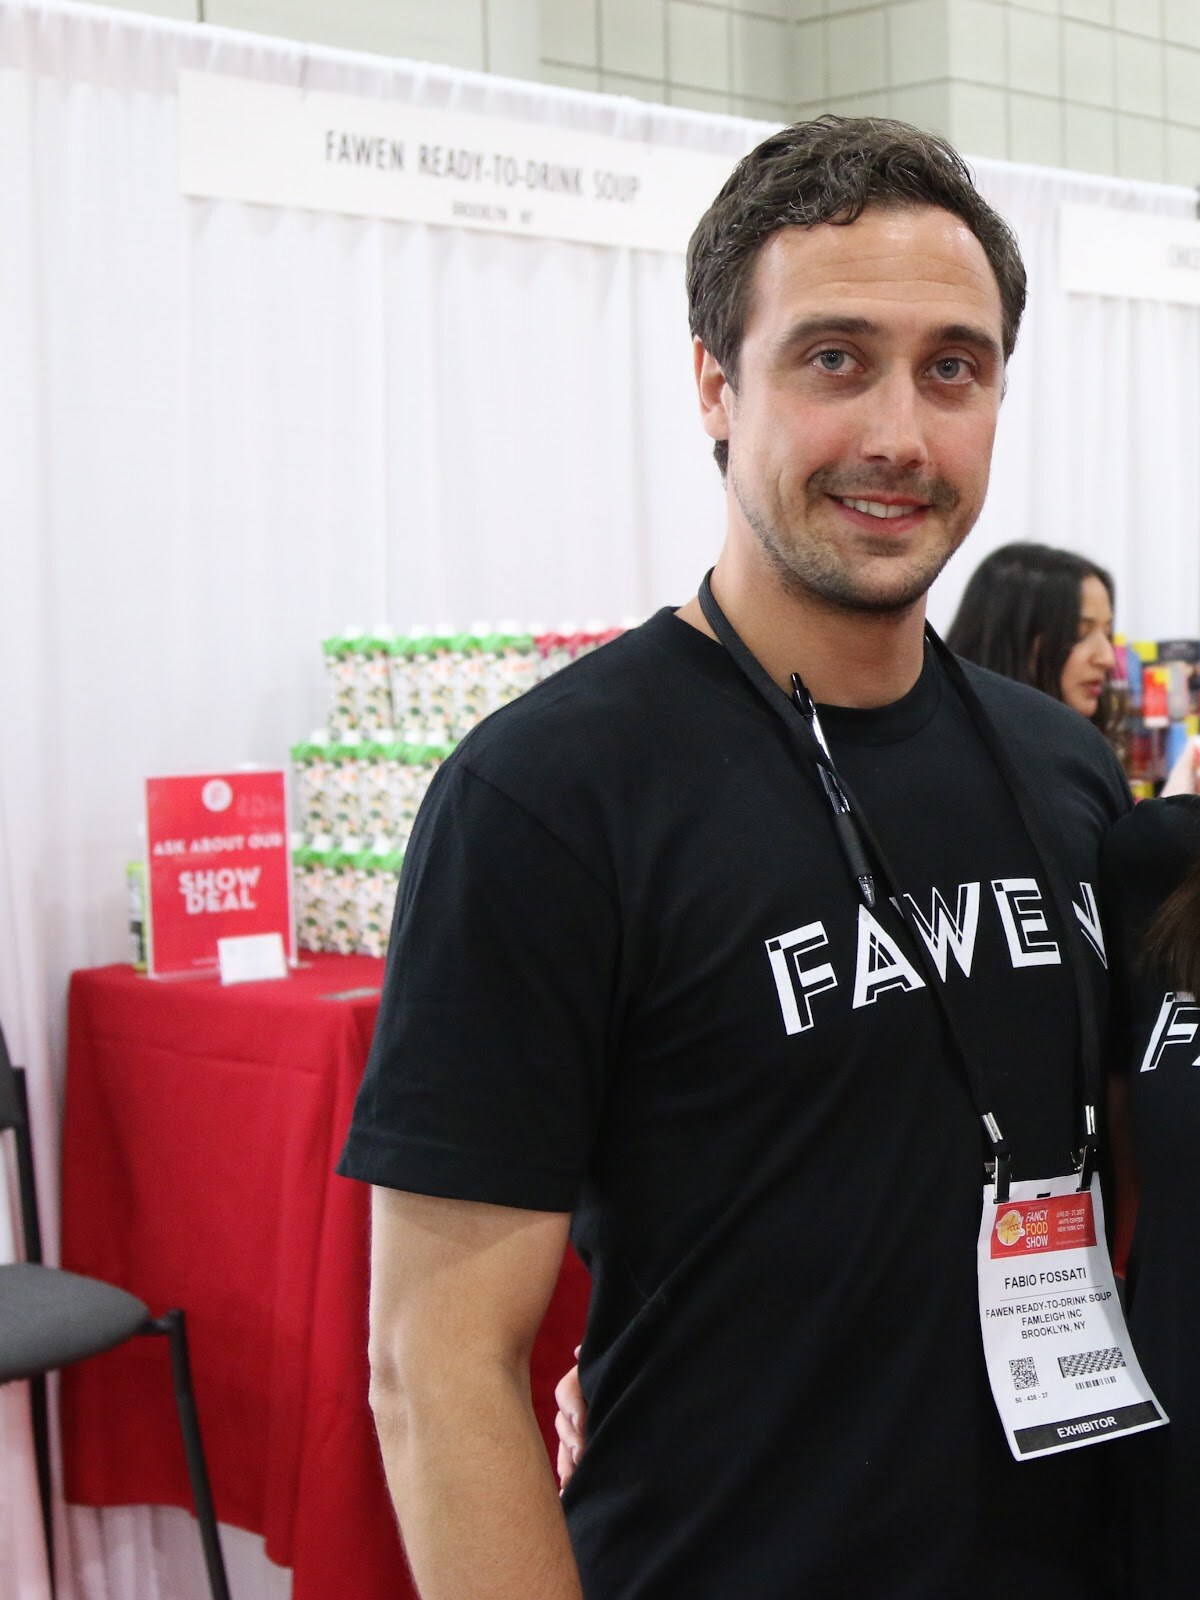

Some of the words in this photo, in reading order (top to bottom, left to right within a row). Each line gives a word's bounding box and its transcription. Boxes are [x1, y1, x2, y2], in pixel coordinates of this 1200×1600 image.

[324, 129, 405, 171] FAWEN
[418, 143, 583, 196] READY-TO-DRINK
[593, 169, 642, 203] SOUP
[153, 840, 185, 857] ASK
[189, 834, 245, 854] ABOUT
[178, 866, 262, 895] SHOW
[185, 888, 256, 916] DEAL
[1026, 1209, 1048, 1222] FANCY
[1026, 1222, 1048, 1235] FOOD
[1026, 1236, 1048, 1248] SHOW
[1004, 1274, 1037, 1290] FABIO
[1039, 1267, 1087, 1285] FOSSATI
[985, 1306, 1014, 1319] FAWEN
[1015, 1296, 1087, 1314] READY-TO-DRINK
[1089, 1291, 1112, 1303] SOUP
[1021, 1311, 1065, 1326] FAMLEIGH
[1067, 1309, 1083, 1319] INC
[1021, 1323, 1073, 1339] BROOKLYN,
[1074, 1321, 1086, 1331] NY
[1056, 1416, 1118, 1438] EXHIBITOR
